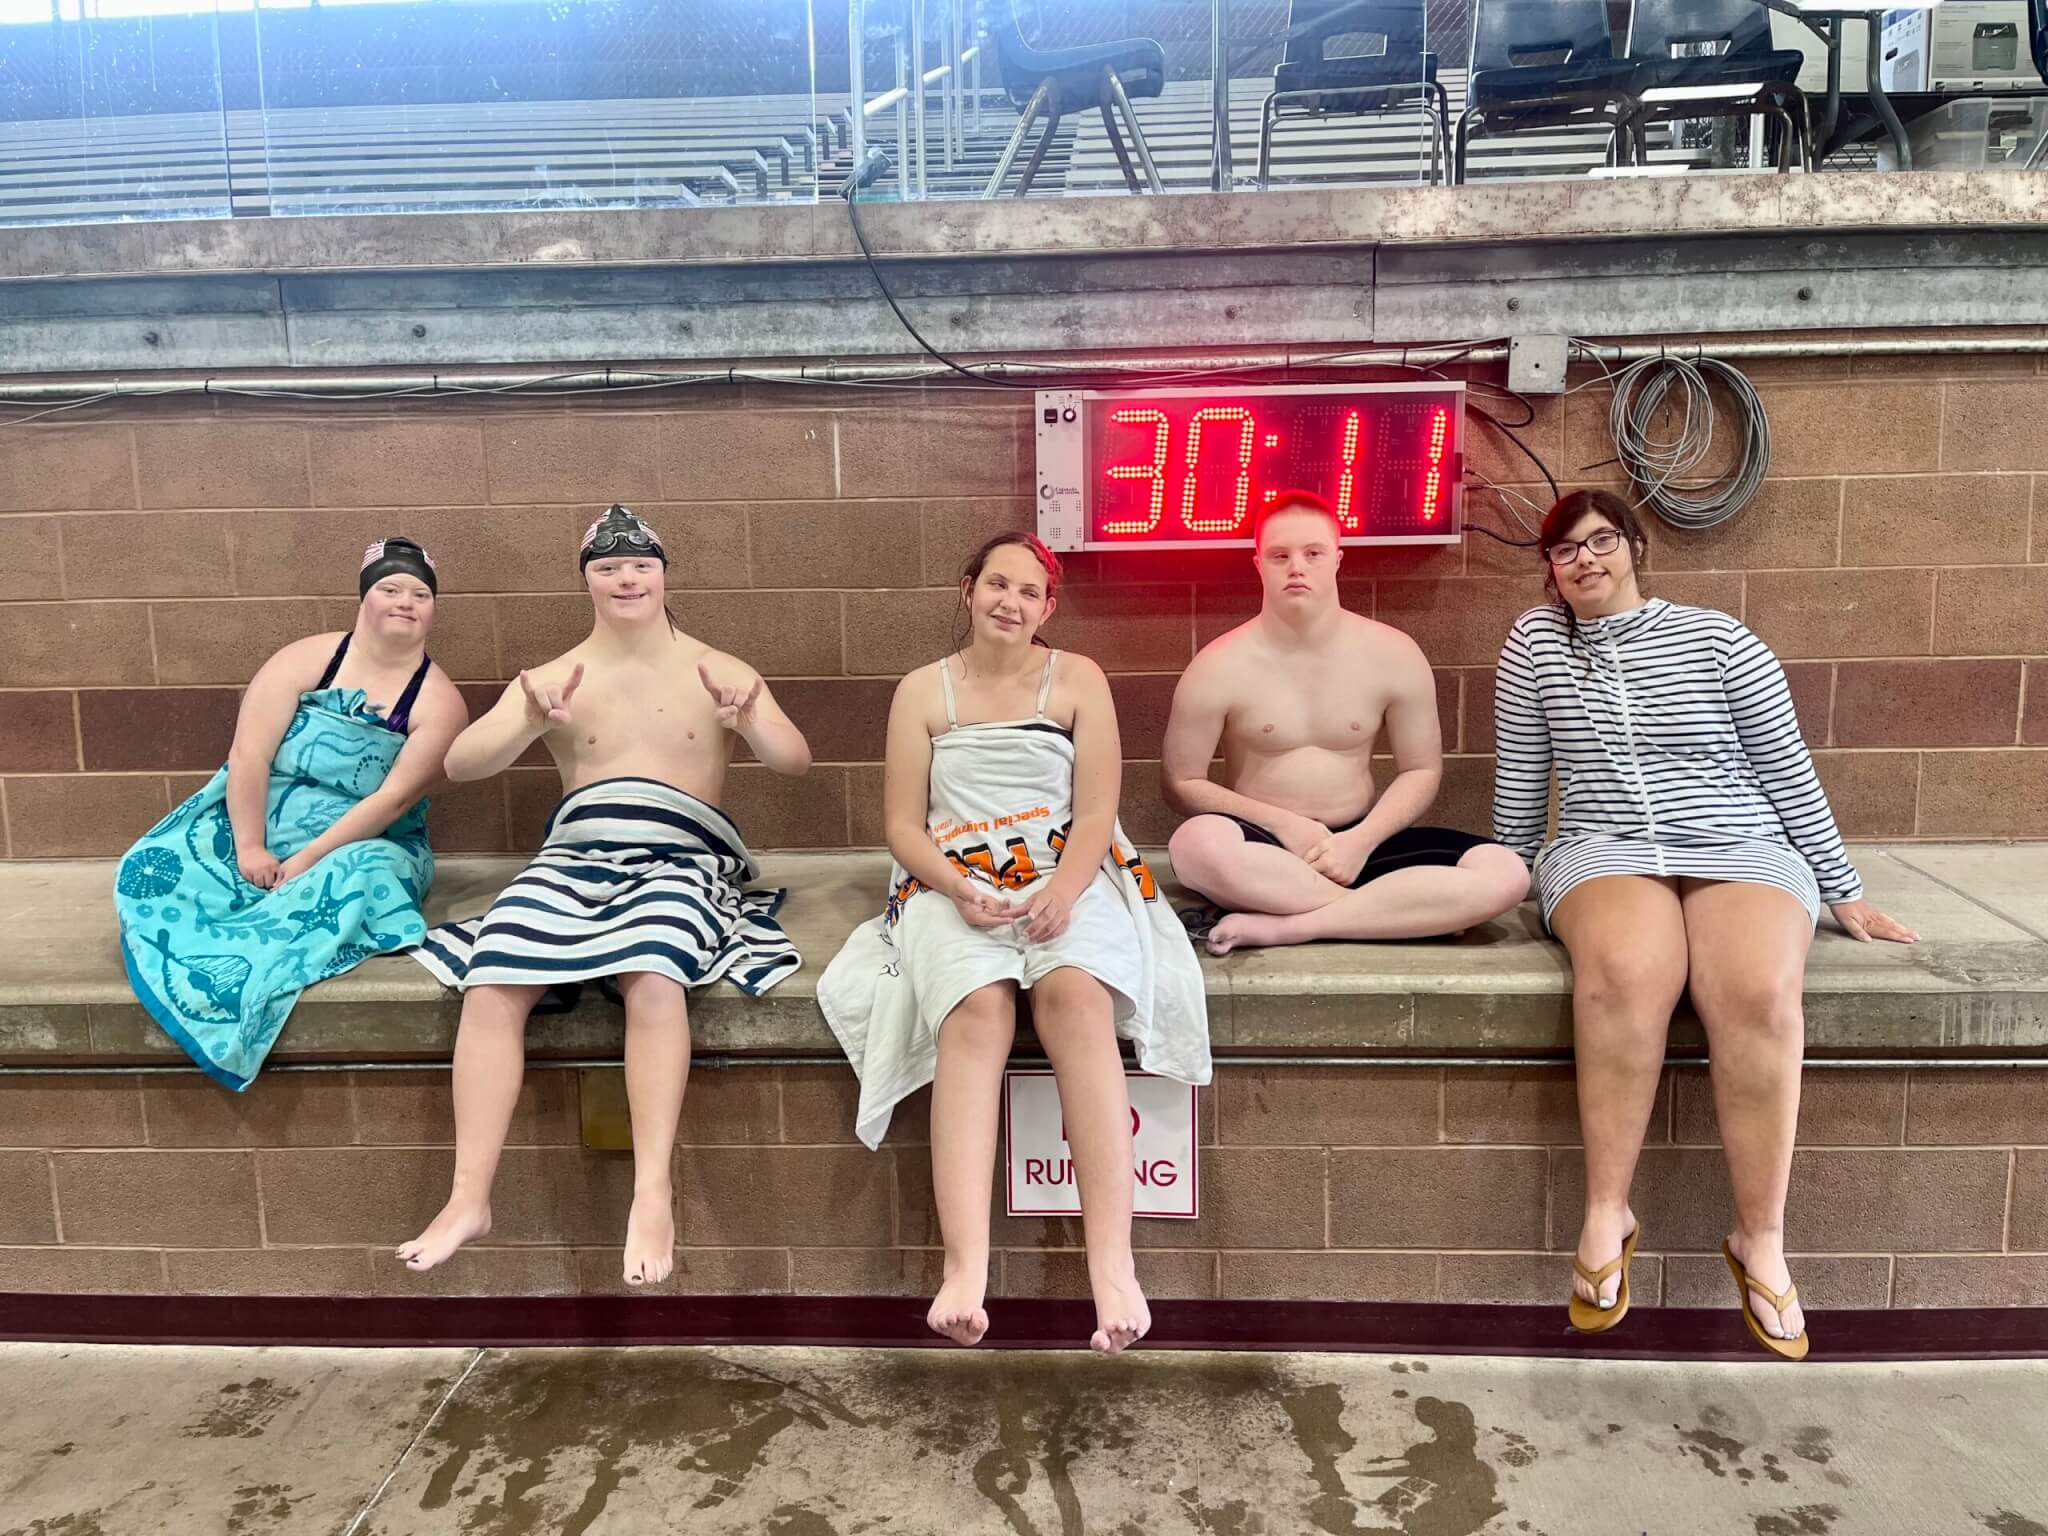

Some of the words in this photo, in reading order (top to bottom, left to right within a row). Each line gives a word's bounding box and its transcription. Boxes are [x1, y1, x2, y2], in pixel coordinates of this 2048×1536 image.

[1102, 406, 1445, 533] 30:11
[994, 806, 1050, 829] Special
[1025, 1158, 1178, 1187] RUNG
